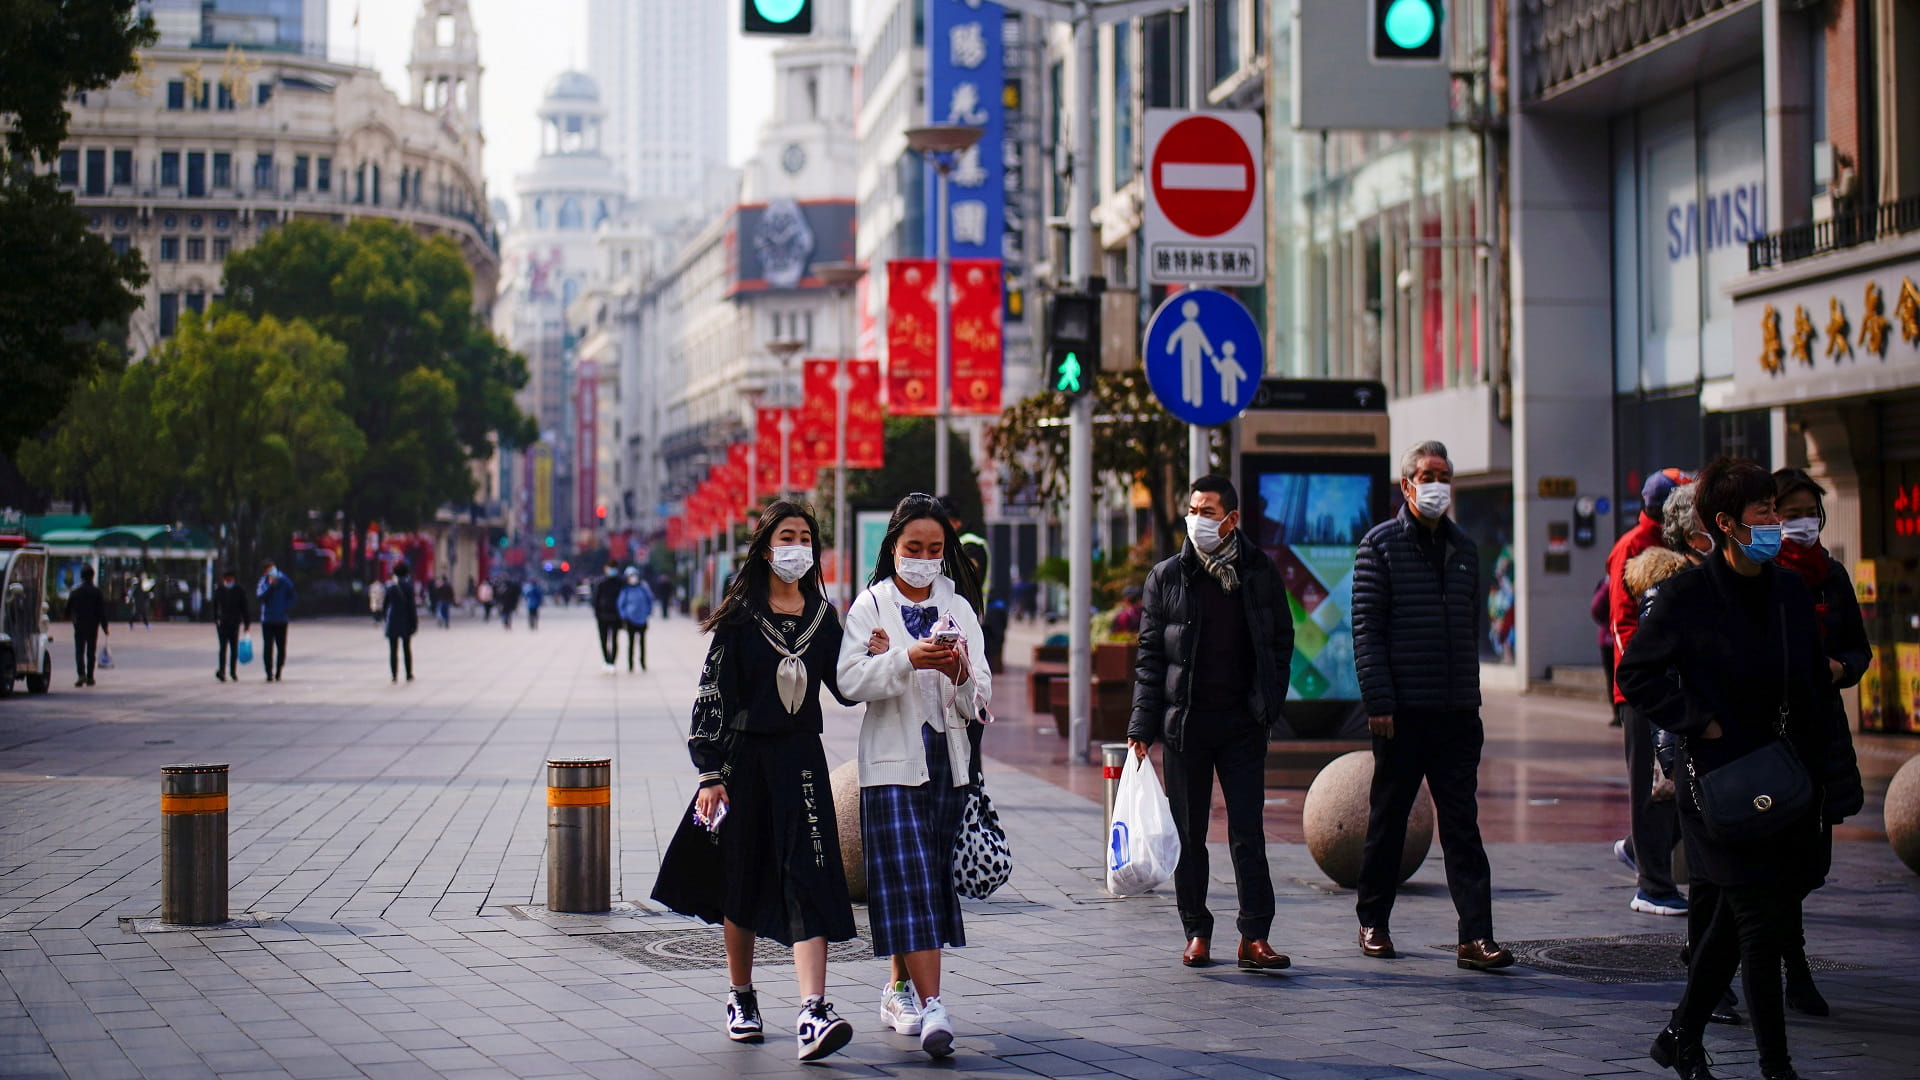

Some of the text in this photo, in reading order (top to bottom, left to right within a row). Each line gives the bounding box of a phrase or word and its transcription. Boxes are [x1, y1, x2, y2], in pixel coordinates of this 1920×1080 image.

[1158, 250, 1250, 272] 除特种车辆外
